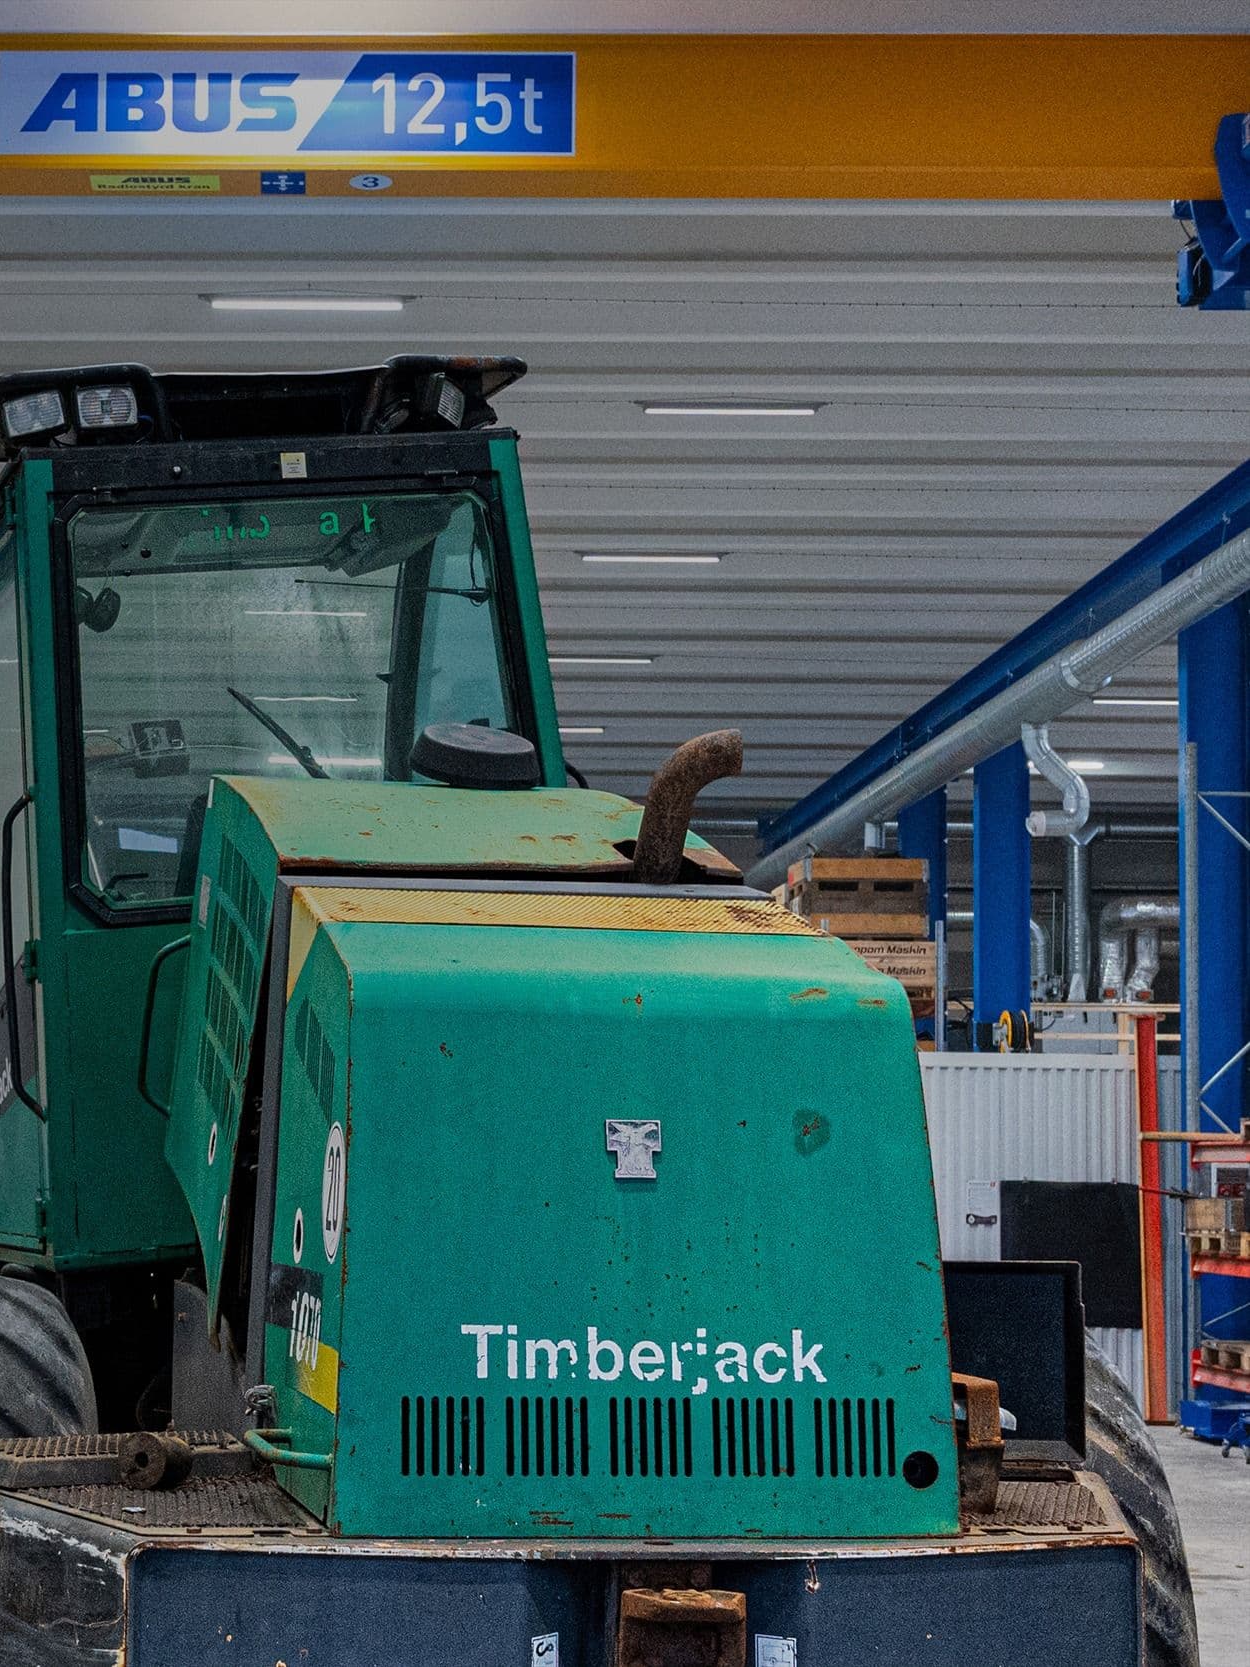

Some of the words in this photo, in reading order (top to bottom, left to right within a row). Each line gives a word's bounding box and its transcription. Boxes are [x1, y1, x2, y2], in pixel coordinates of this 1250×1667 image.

[20, 72, 301, 133] ABUS
[370, 72, 544, 147] 12,5t
[361, 176, 379, 188] 3
[886, 945, 927, 955] Maskin
[886, 966, 927, 976] Maskin
[325, 1145, 341, 1233] 20
[460, 1324, 828, 1396] Timberjack
